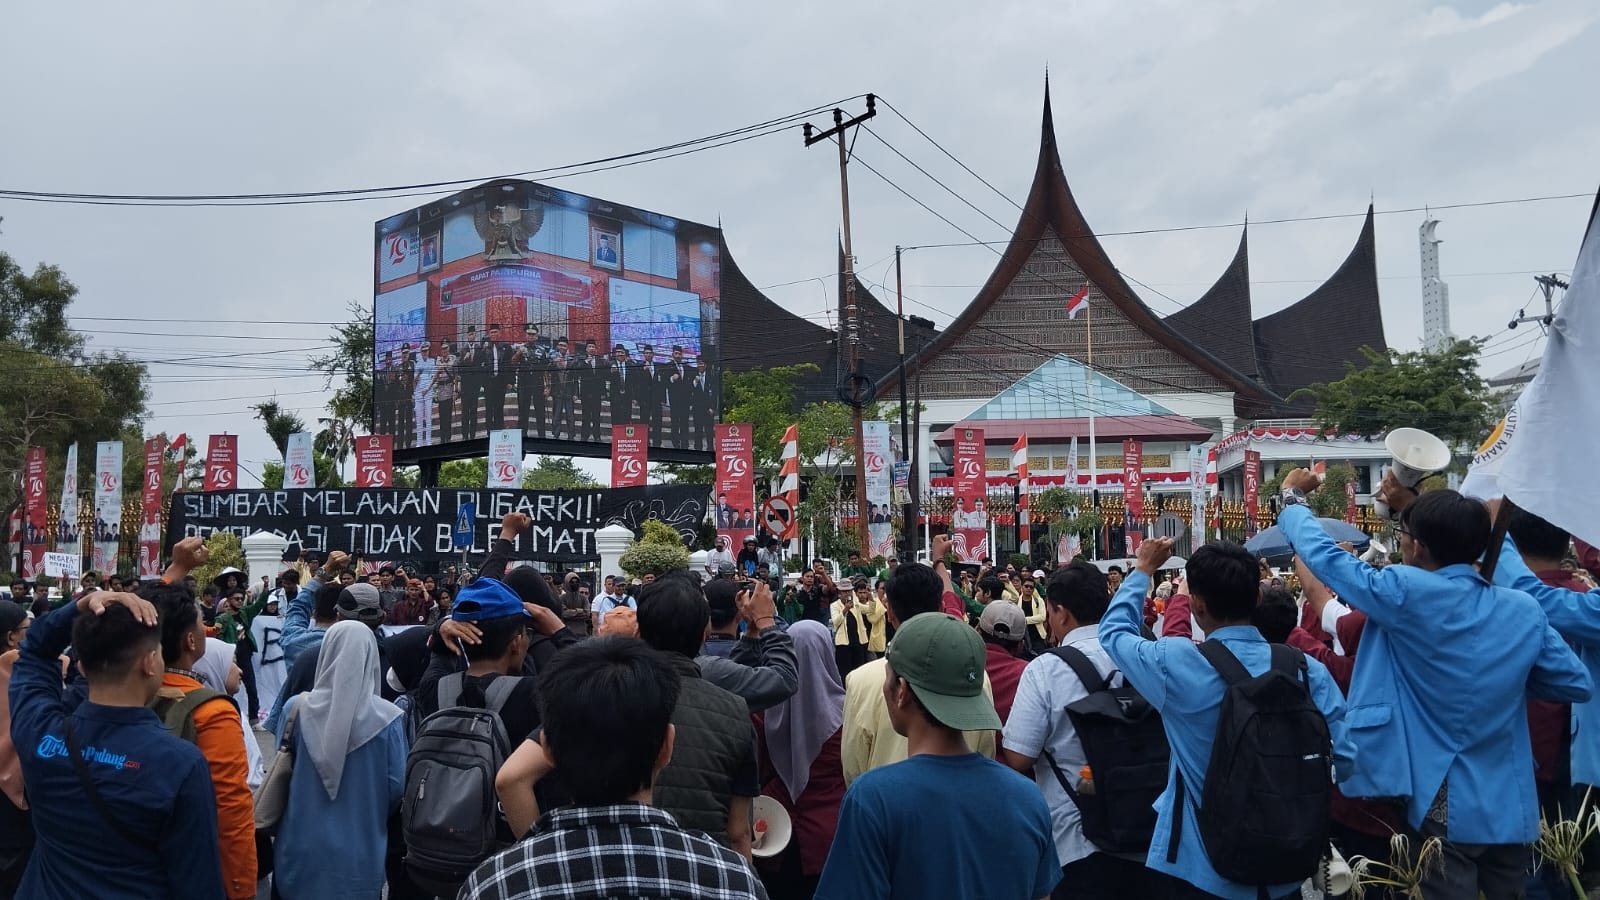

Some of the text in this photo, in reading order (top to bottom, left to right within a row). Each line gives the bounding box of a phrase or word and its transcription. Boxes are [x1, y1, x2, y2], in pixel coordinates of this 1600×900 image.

[471, 271, 489, 282] RAPAT
[211, 465, 232, 488] 79
[291, 463, 309, 486] 79
[362, 465, 387, 488] 79
[494, 460, 517, 483] 79
[617, 455, 642, 478] 79
[722, 454, 747, 477] 79
[958, 457, 981, 479] 79
[1126, 467, 1139, 487] 79
[29, 476, 43, 497] 79
[100, 471, 117, 492] 79
[147, 468, 160, 490] 79
[1246, 473, 1257, 493] 79
[184, 491, 290, 518] SUMBAR
[303, 489, 441, 517] MELAWAN
[343, 523, 423, 555] TIDAK
